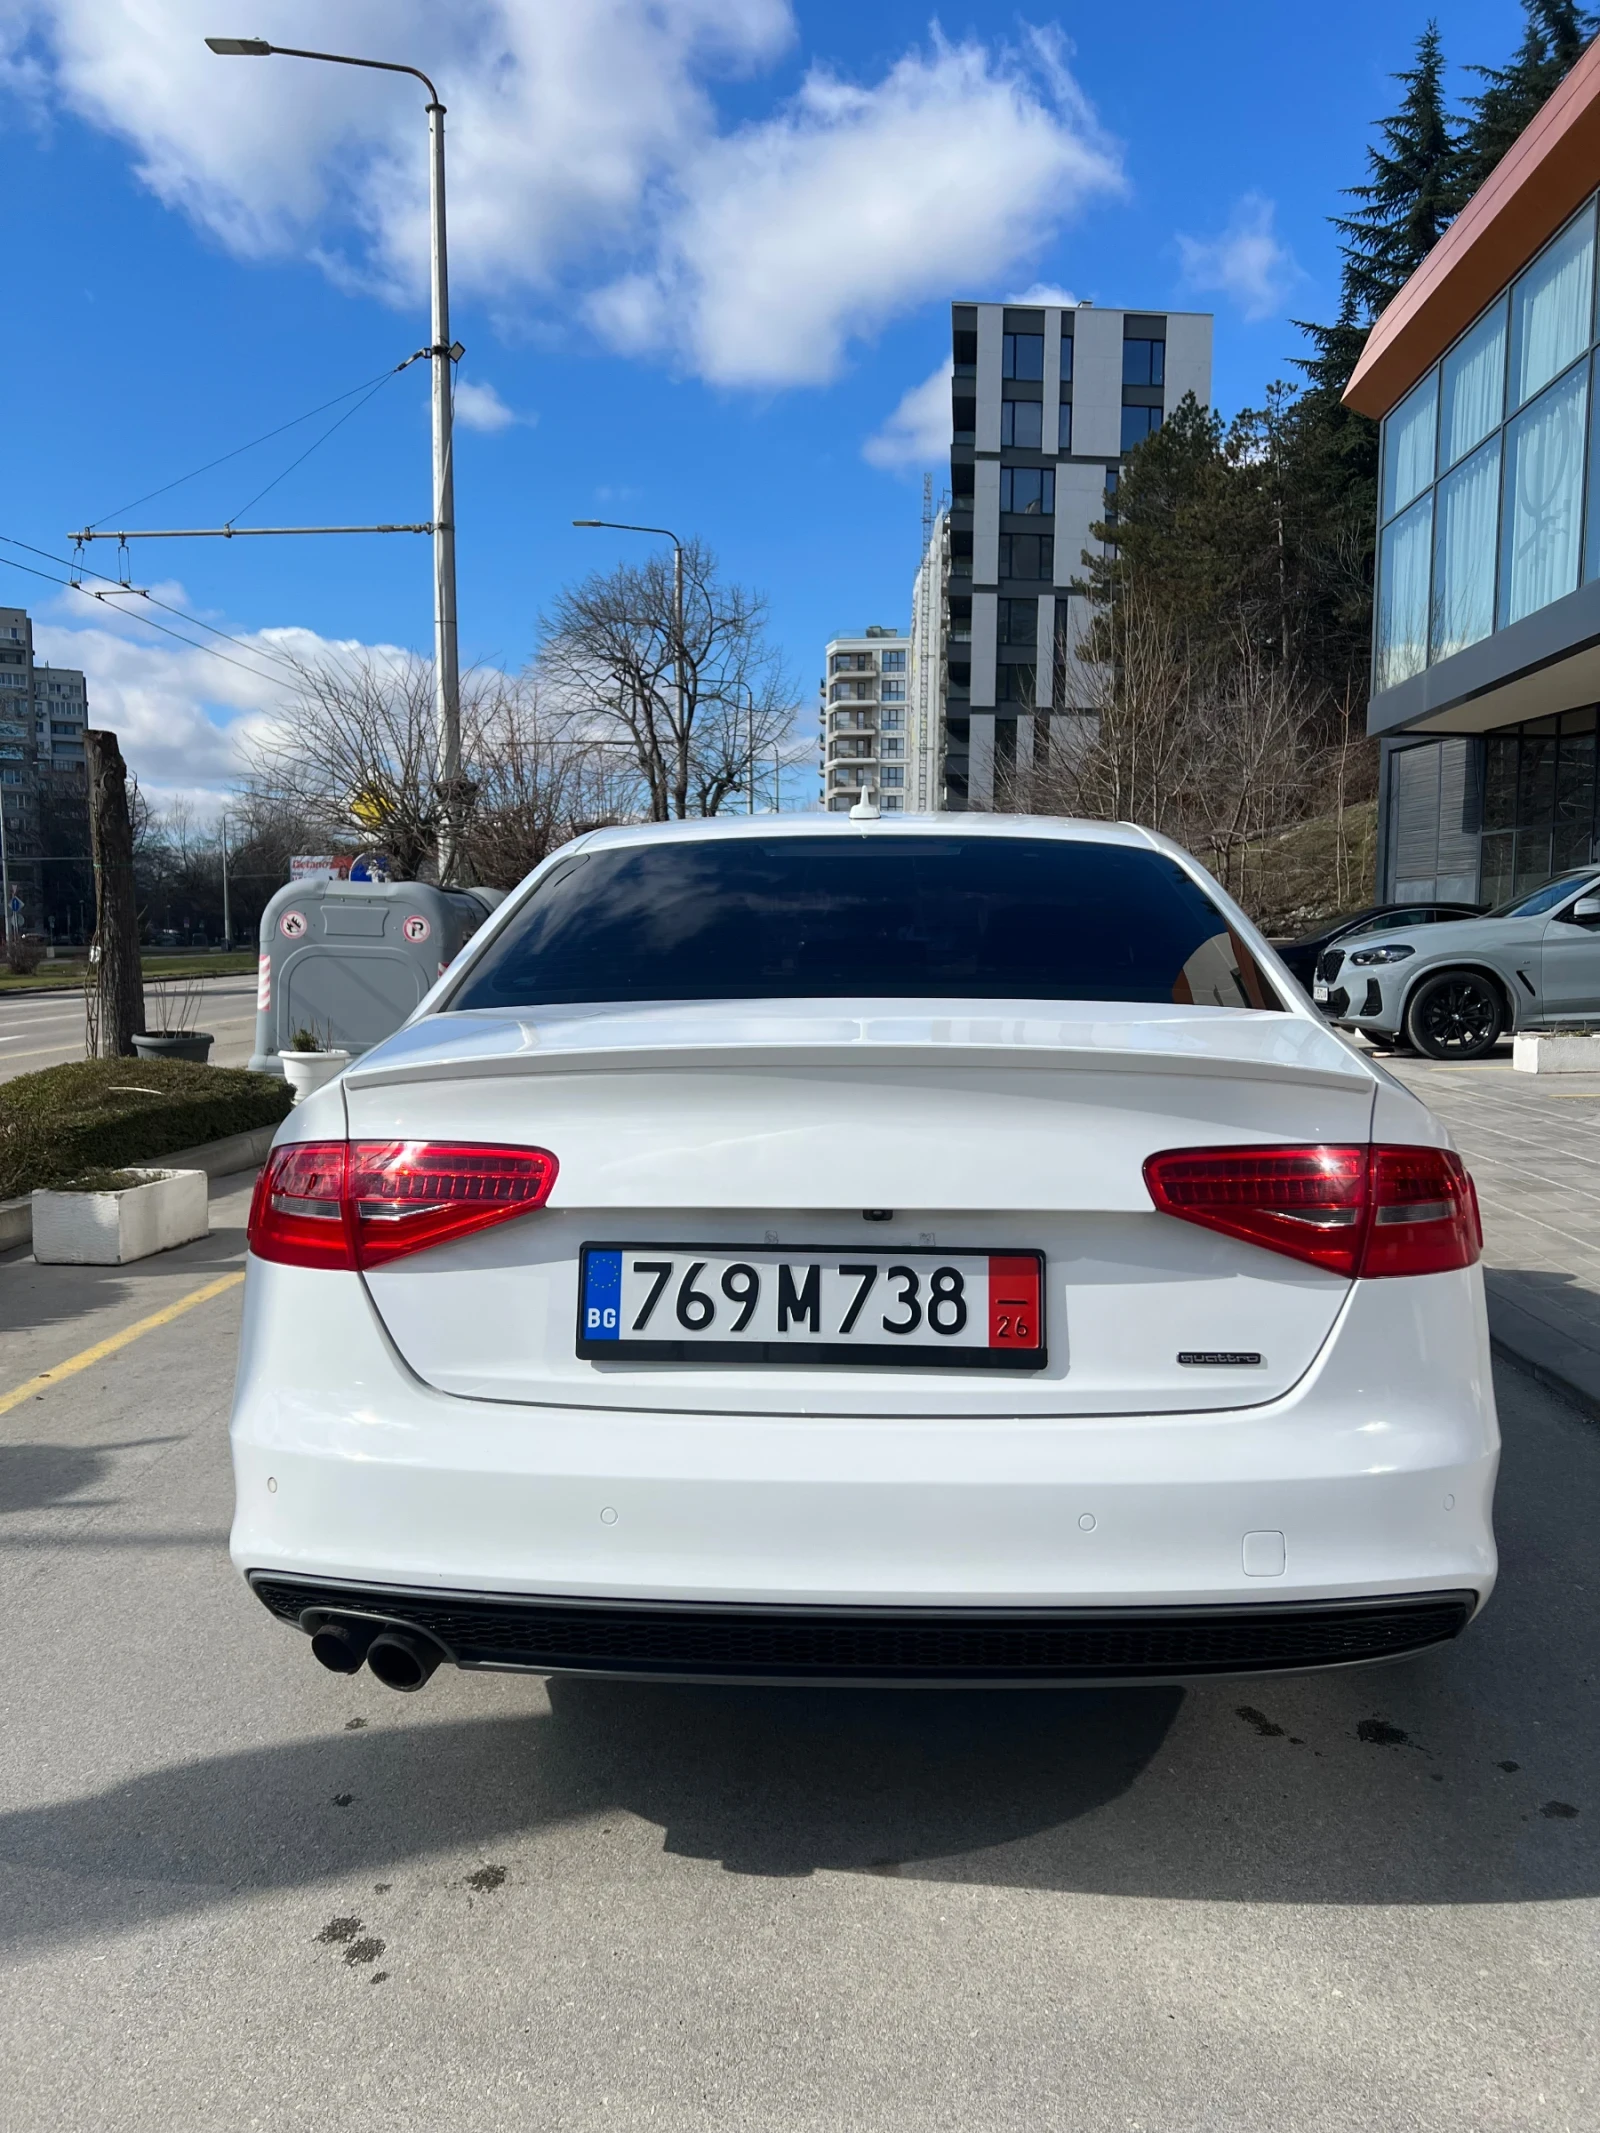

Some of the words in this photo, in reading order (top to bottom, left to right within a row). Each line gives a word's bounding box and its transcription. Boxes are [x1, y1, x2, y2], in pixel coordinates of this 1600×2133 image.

[587, 1307, 616, 1329] BG
[996, 1315, 1028, 1338] 26
[1180, 1353, 1259, 1364] quattro
